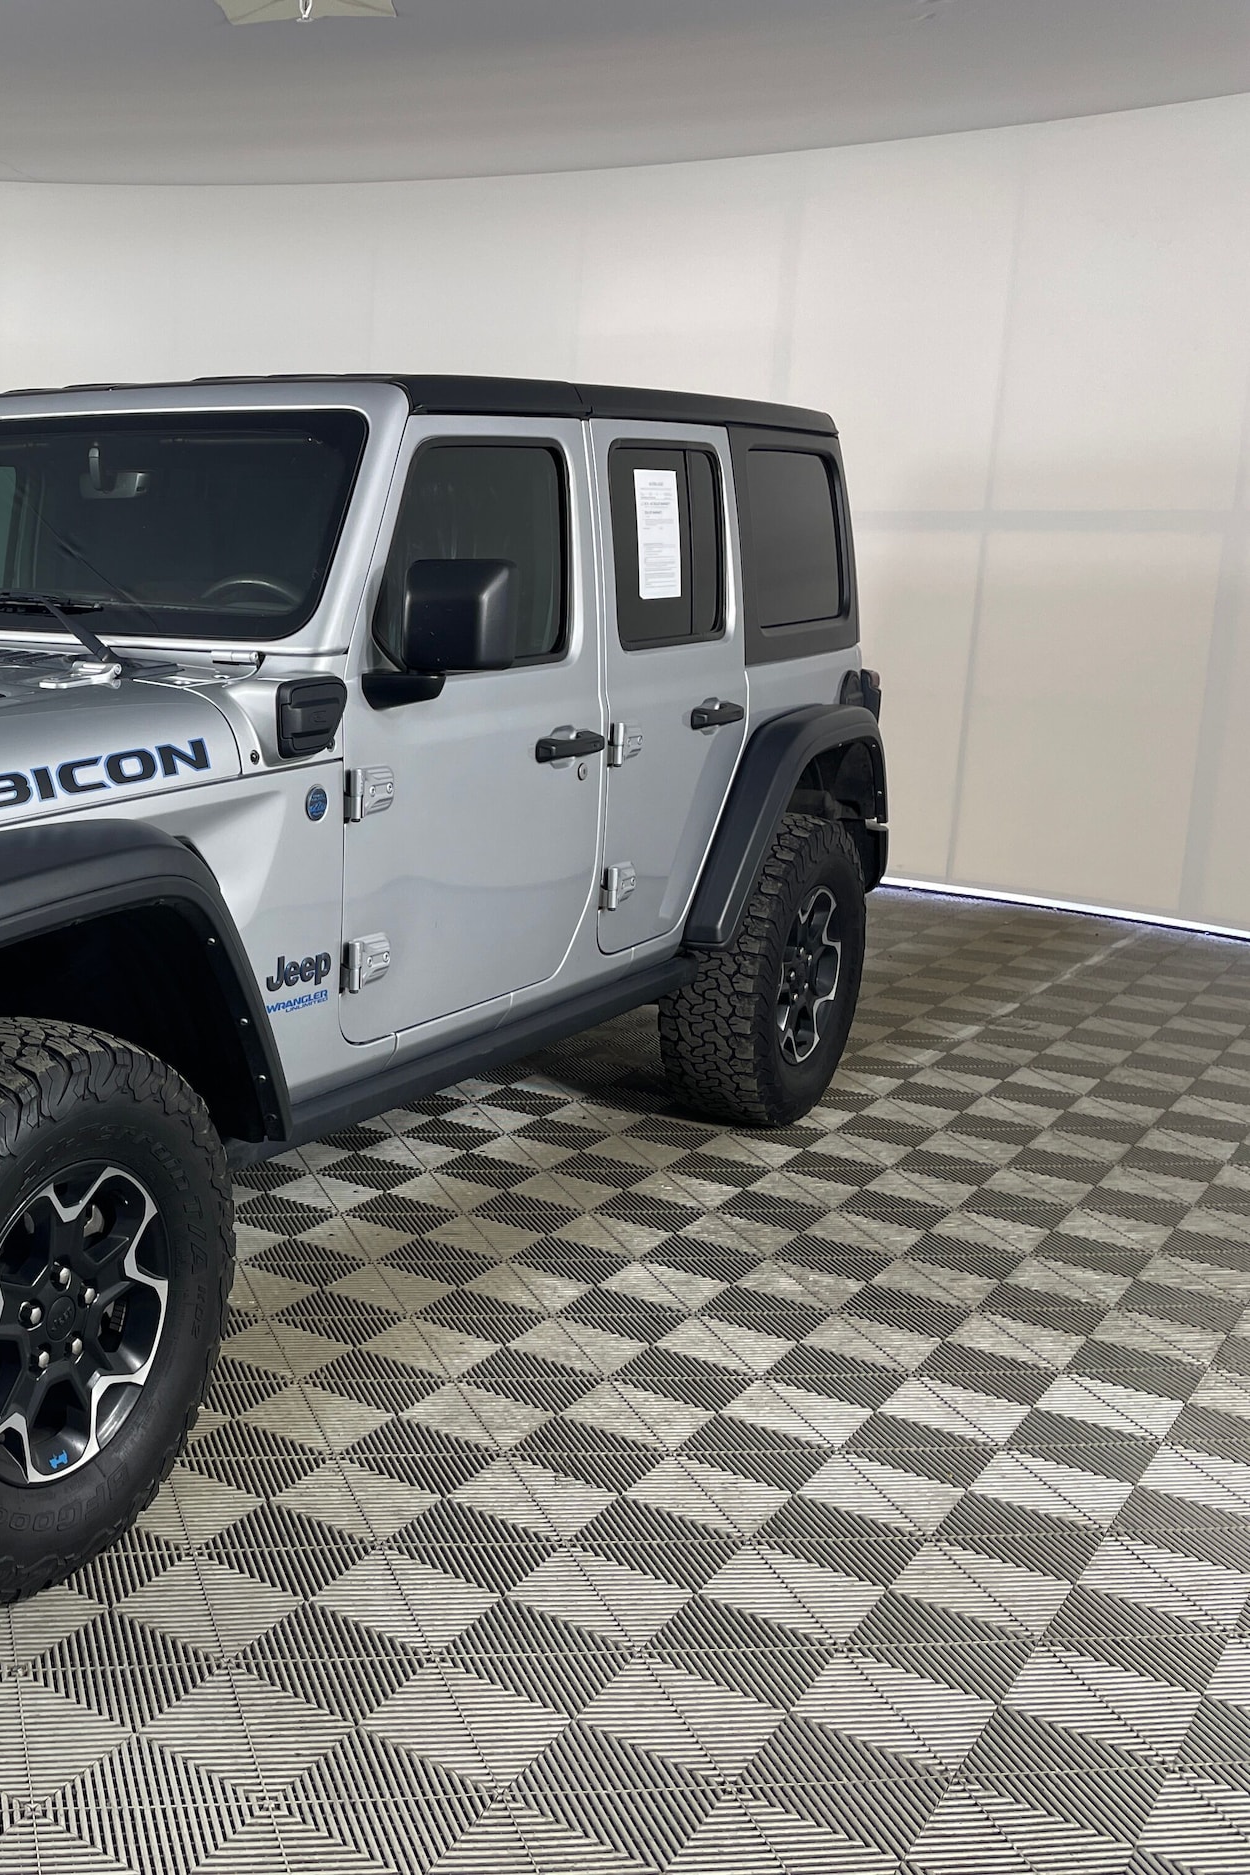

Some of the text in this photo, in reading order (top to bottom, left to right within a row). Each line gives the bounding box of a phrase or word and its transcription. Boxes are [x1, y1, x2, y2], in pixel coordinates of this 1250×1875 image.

[266, 952, 331, 992] Jeep
[266, 989, 328, 1014] WRANGLER
[285, 997, 328, 1013] UNLIMITED
